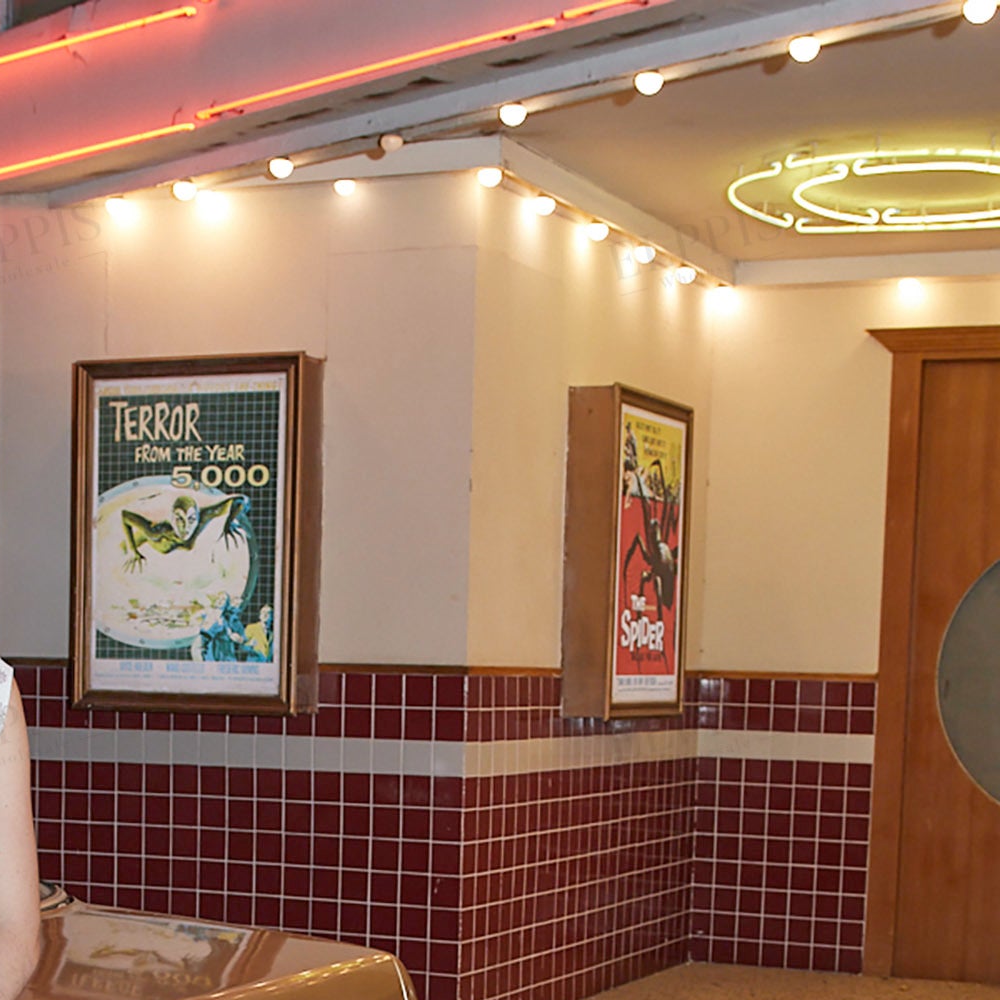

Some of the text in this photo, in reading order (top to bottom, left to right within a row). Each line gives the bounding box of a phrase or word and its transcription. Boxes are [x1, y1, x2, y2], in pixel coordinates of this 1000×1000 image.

[109, 401, 202, 442] TERROR
[135, 443, 246, 463] FROM THE YEAR
[171, 464, 270, 490] 5,000
[620, 609, 665, 652] SPIDER
